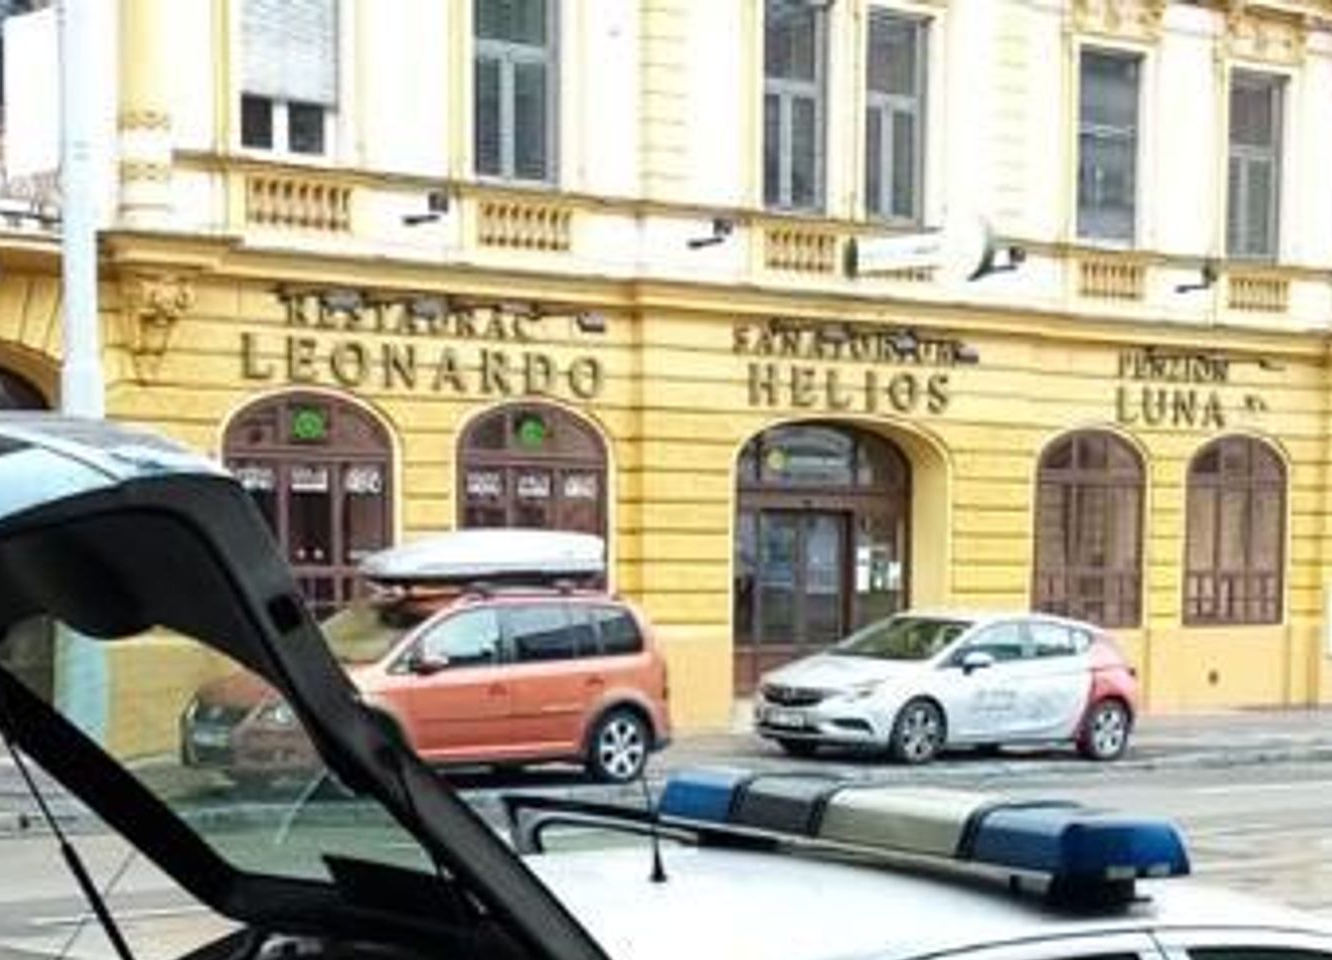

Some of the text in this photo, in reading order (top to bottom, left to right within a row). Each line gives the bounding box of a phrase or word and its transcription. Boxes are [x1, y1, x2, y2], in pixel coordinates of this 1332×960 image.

[240, 332, 602, 399] LEONARDO
[747, 362, 949, 414] HELIOS
[1116, 386, 1225, 428] LUNA
